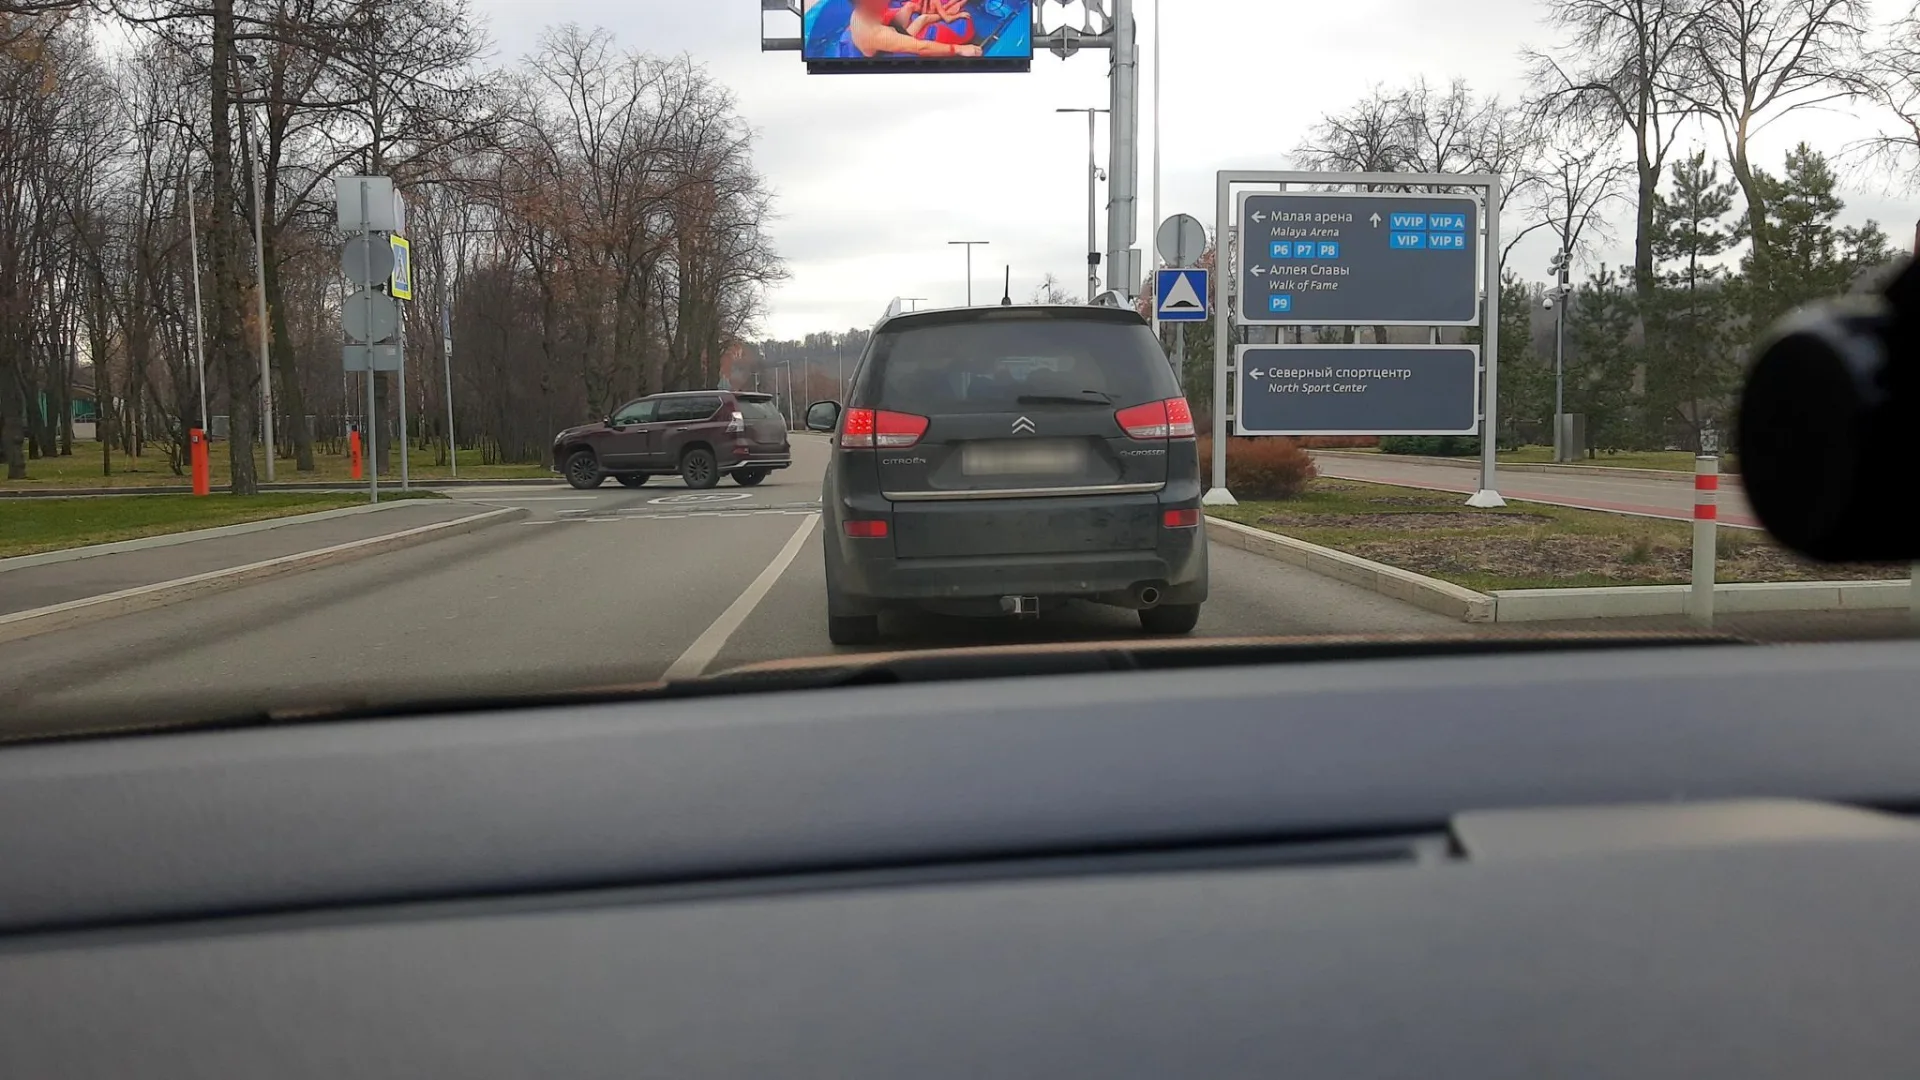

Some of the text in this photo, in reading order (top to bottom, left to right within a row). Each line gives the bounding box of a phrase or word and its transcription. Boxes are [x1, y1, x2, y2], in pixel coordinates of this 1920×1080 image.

[1271, 211, 1353, 224] Малая арена
[1394, 216, 1464, 228] VVIP VIP A
[1270, 227, 1340, 238] Malaya Arena
[1397, 235, 1464, 247] VIP VIP B
[1274, 245, 1335, 255] P6 P7 P8
[1269, 265, 1350, 276] Аллея Славы
[1269, 280, 1339, 292] Walk of Fame
[1273, 298, 1287, 309] P9
[1268, 367, 1412, 381] Северный спортцентр
[1268, 383, 1367, 395] North Sport Center
